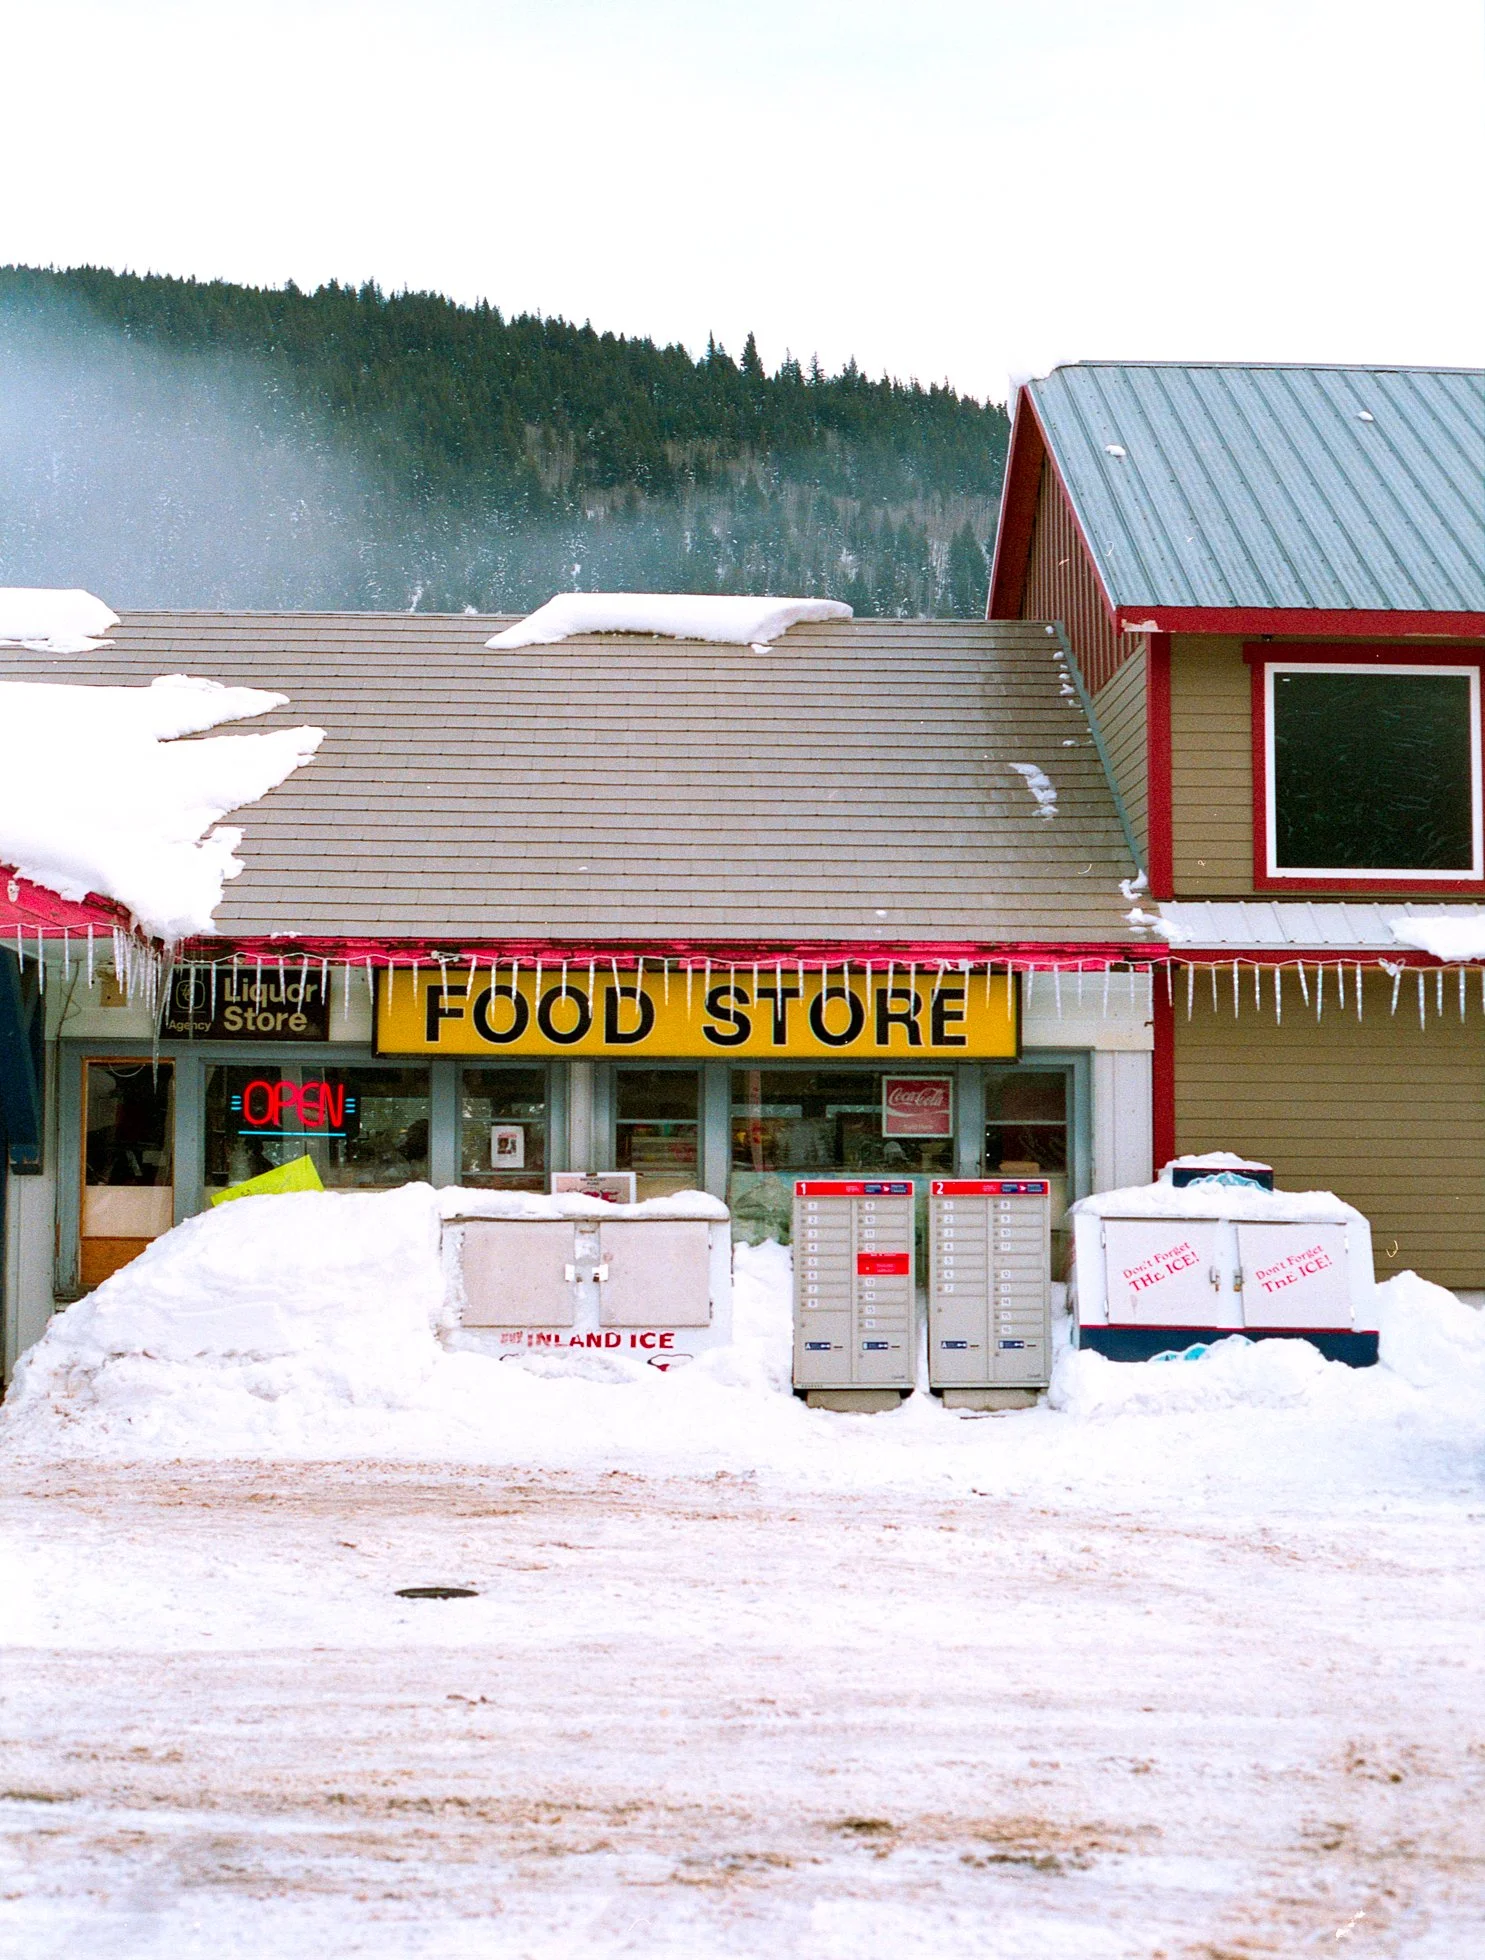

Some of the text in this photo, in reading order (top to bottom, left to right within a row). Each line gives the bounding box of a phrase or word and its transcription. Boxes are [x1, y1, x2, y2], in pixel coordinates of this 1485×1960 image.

[224, 977, 318, 1008] Liquor
[168, 1020, 212, 1032] Agency
[223, 1006, 308, 1032] Store
[425, 984, 969, 1048] FOOD STORE
[243, 1080, 344, 1128] OPEN
[801, 1182, 807, 1195] 1
[936, 1182, 944, 1195] 2
[1153, 1241, 1192, 1264] Forget
[1165, 1251, 1200, 1275] ICE!
[1255, 1244, 1324, 1281] Don't Forget
[1299, 1253, 1334, 1278] ICE!
[527, 1332, 621, 1348] INLAND
[630, 1332, 675, 1349] ICE
